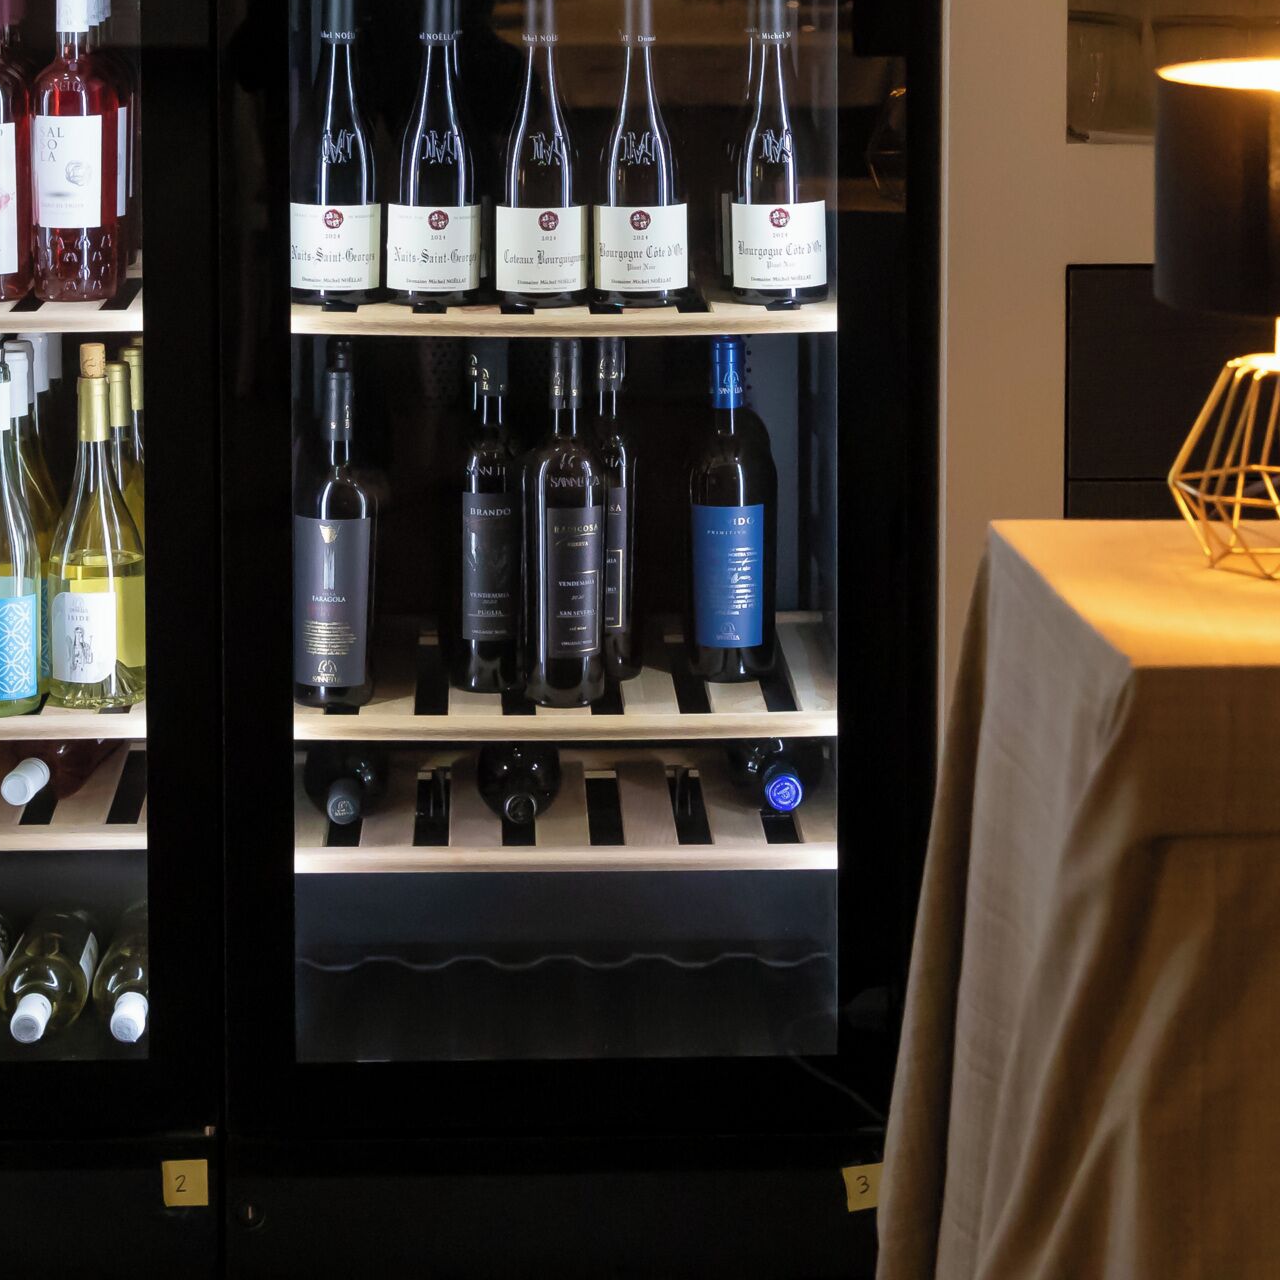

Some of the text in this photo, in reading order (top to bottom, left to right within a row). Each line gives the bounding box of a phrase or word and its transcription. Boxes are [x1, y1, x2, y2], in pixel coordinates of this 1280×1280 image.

[426, 30, 454, 41] NOËLL
[761, 32, 785, 40] Michel
[40, 151, 57, 163] LA
[503, 249, 534, 265] Coteaux
[599, 242, 644, 263] Bourgogne
[646, 244, 666, 259] Côte
[737, 240, 783, 261] Bourgogne
[785, 241, 806, 257] Côte
[470, 507, 512, 517] BRANDO
[175, 1174, 187, 1193] 2
[856, 1175, 870, 1194] 3
